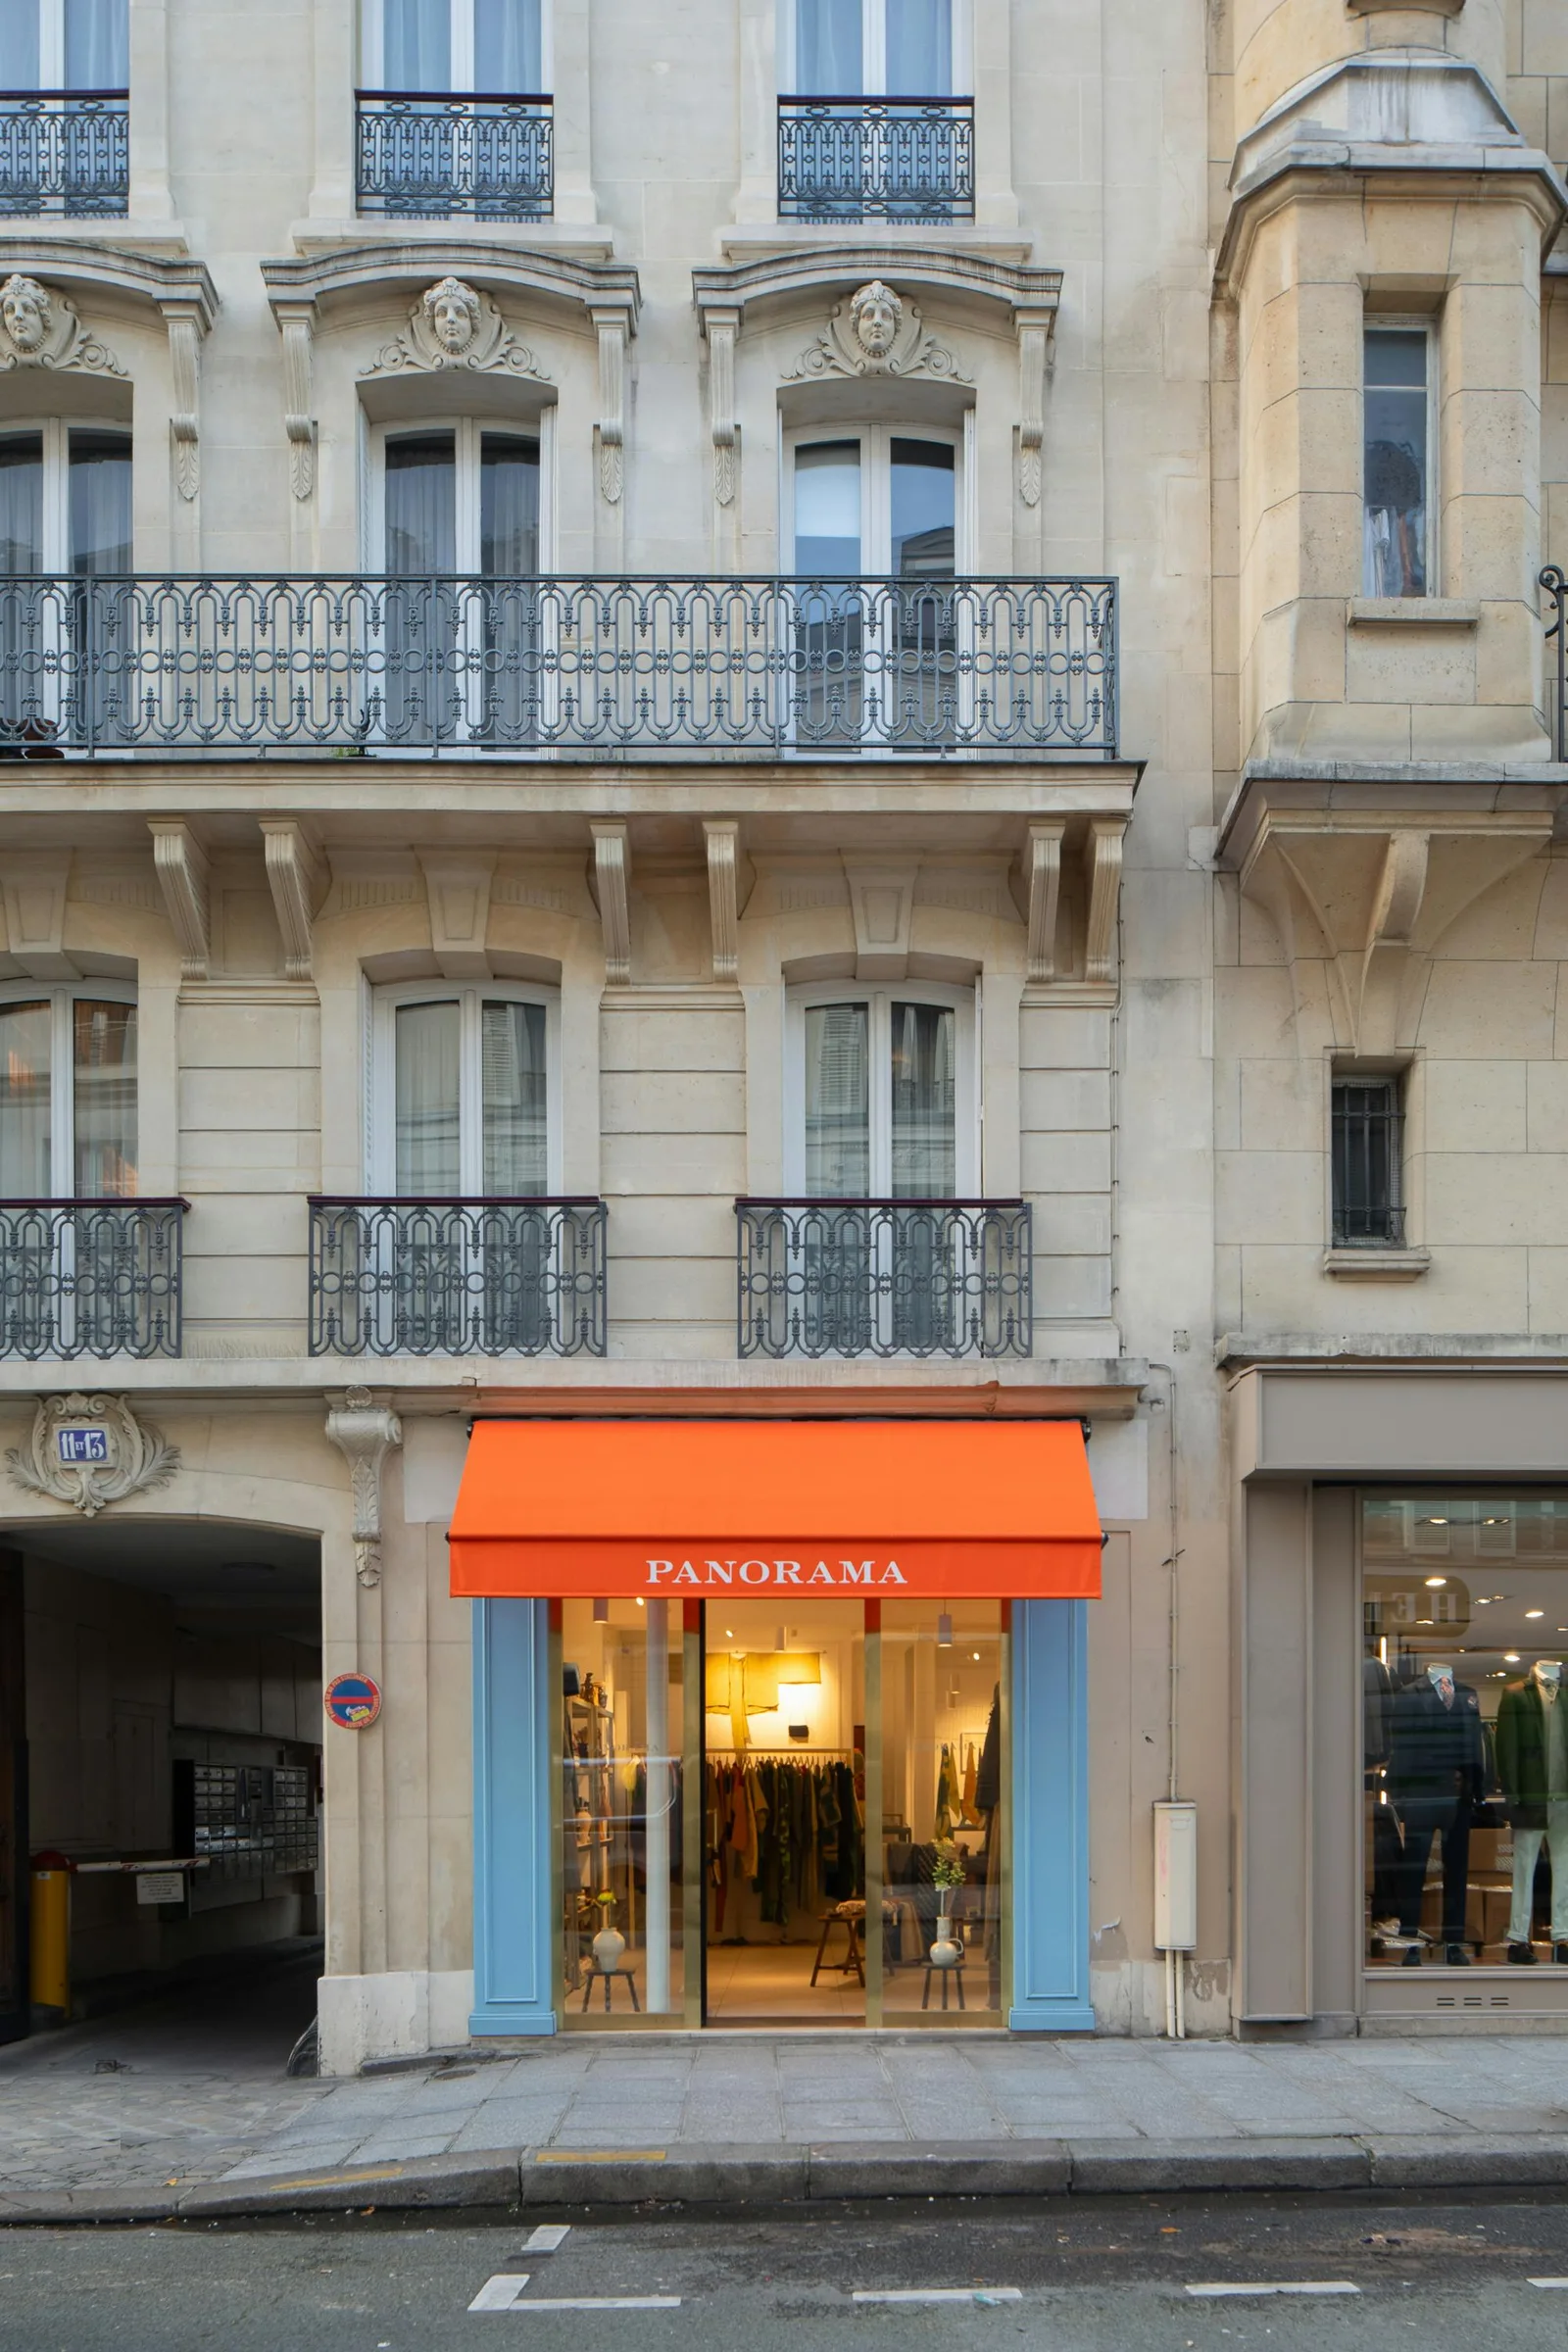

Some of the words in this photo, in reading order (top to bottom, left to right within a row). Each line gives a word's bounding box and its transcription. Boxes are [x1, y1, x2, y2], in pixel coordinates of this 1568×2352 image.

[62, 1433, 76, 1459] 11
[84, 1433, 104, 1459] 13
[646, 1560, 907, 1584] PANORAMA
